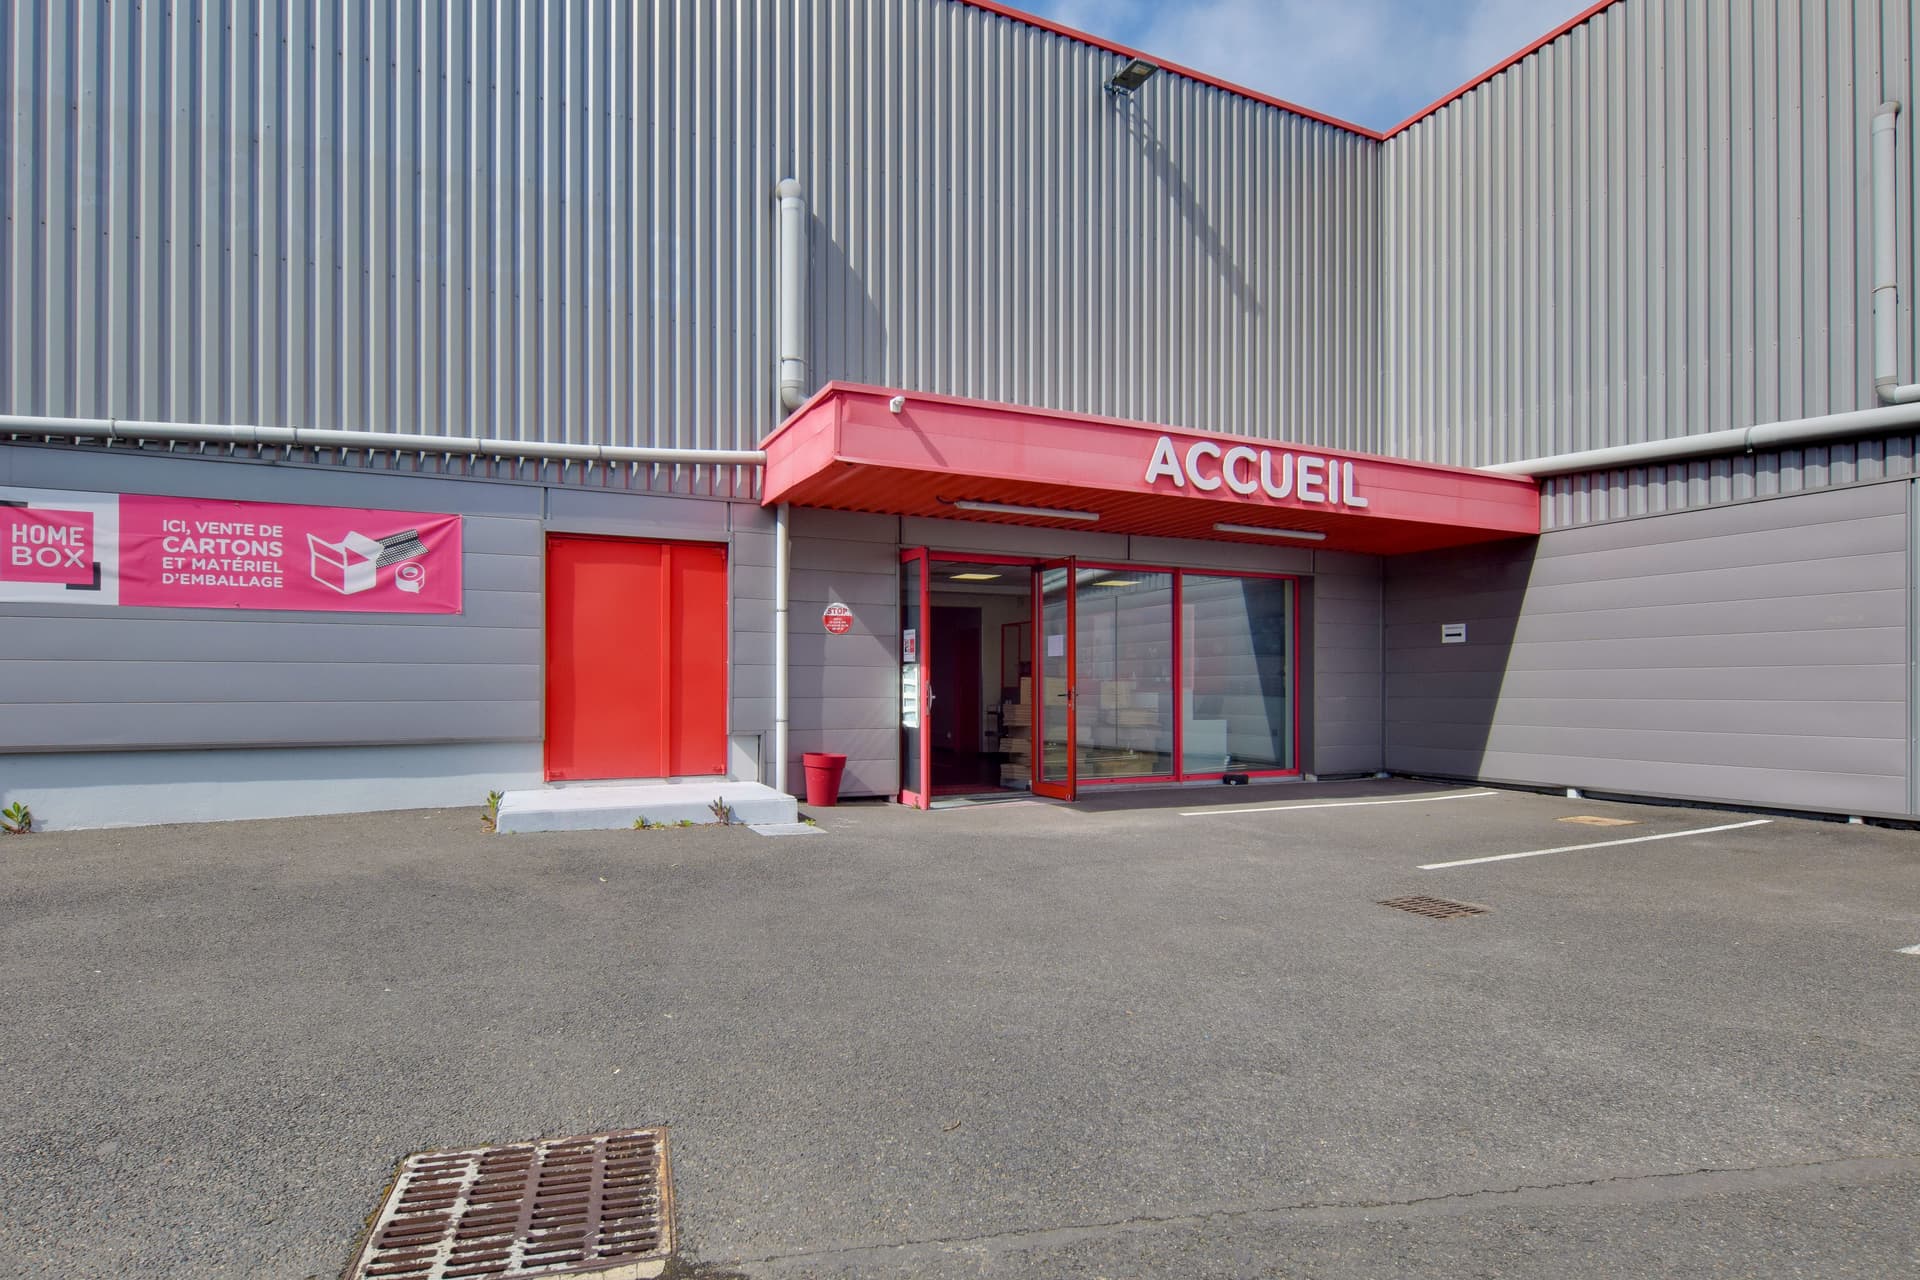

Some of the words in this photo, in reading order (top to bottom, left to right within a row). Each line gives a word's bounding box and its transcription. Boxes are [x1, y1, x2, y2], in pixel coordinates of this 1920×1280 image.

[1145, 436, 1368, 507] ACCUEIL
[11, 523, 85, 547] HOME
[162, 519, 191, 535] ICI,
[195, 521, 255, 537] VENTE
[259, 524, 284, 538] DE
[11, 546, 85, 568] BOX
[162, 536, 284, 557] CARTONS
[162, 557, 186, 569] ET
[191, 556, 284, 573] MATÉRIEL
[827, 607, 848, 615] STOP
